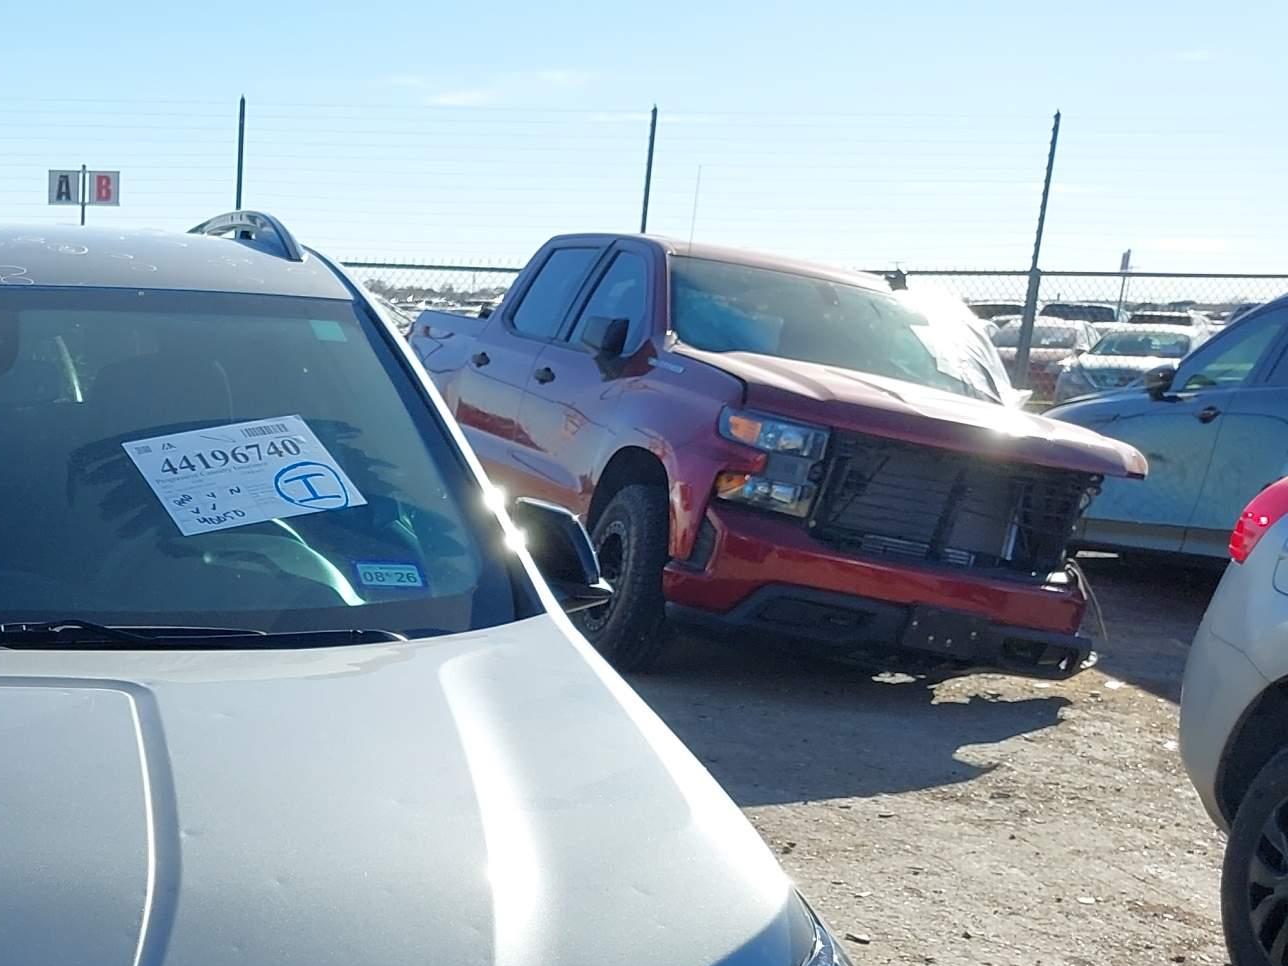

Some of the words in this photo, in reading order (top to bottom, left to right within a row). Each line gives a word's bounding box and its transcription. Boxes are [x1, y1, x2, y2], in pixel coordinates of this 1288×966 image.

[56, 174, 72, 201] A
[95, 175, 112, 201] B
[160, 438, 301, 475] 44196740
[362, 571, 386, 583] 08
[394, 572, 418, 583] 26
